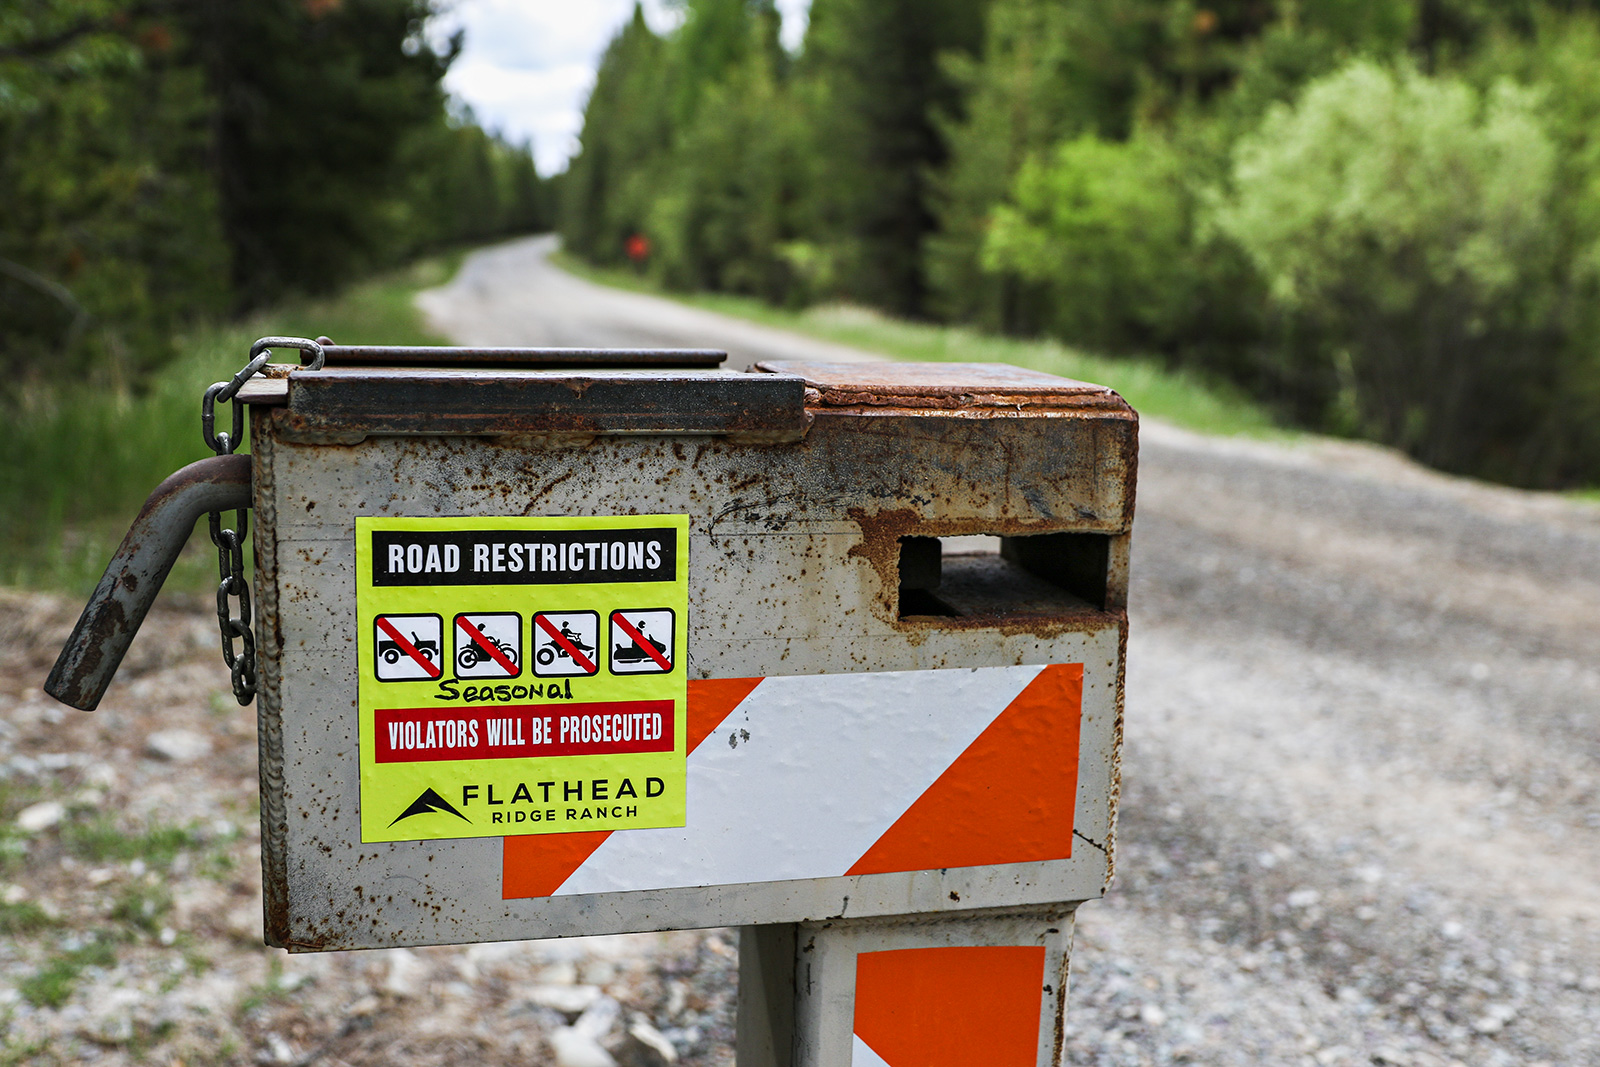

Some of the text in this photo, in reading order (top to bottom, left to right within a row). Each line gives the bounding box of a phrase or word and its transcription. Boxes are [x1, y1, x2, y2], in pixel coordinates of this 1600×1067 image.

[388, 540, 662, 574] ROAD RESTRICTIONS
[388, 712, 663, 750] VIOLATORS WILL BE PROSECUTED
[462, 776, 666, 806] FLATHEAD
[492, 805, 638, 824] RIDGE RANCH
